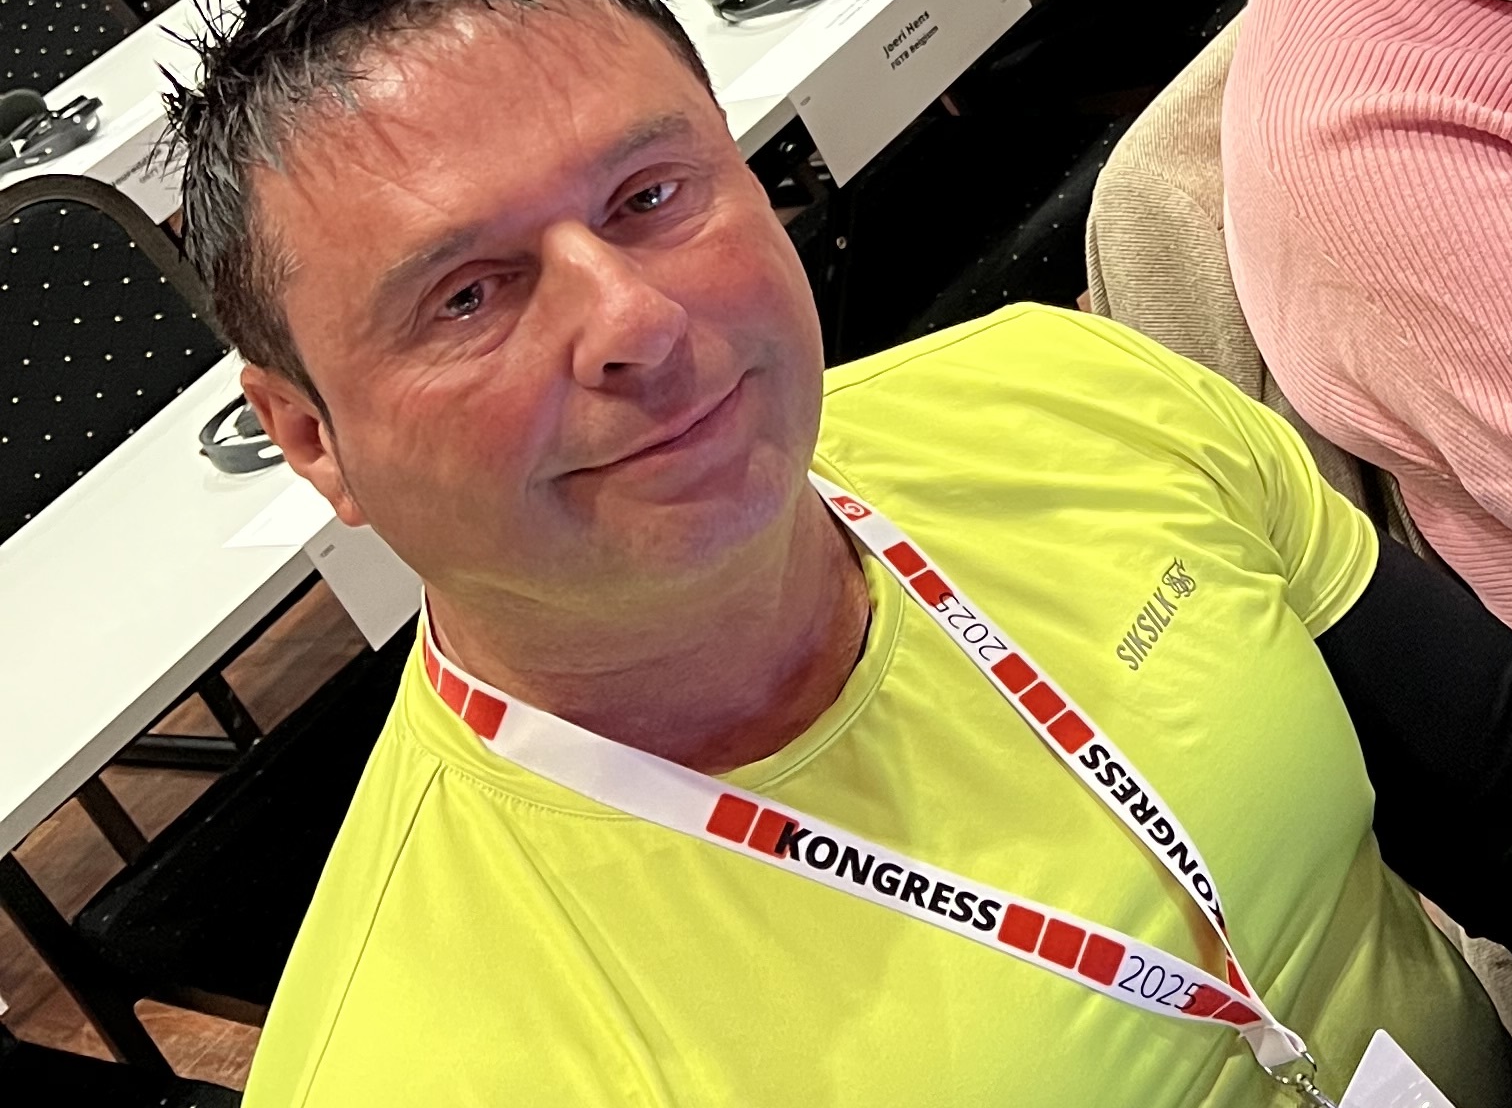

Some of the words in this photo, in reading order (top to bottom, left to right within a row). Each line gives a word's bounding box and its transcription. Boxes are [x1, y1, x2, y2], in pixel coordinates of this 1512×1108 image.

[937, 592, 1008, 661] 2025
[1116, 586, 1178, 671] SIKSILK
[1079, 744, 1226, 926] KONGRESS
[773, 821, 1002, 932] KONGRESS
[1118, 956, 1205, 1011] 2025
